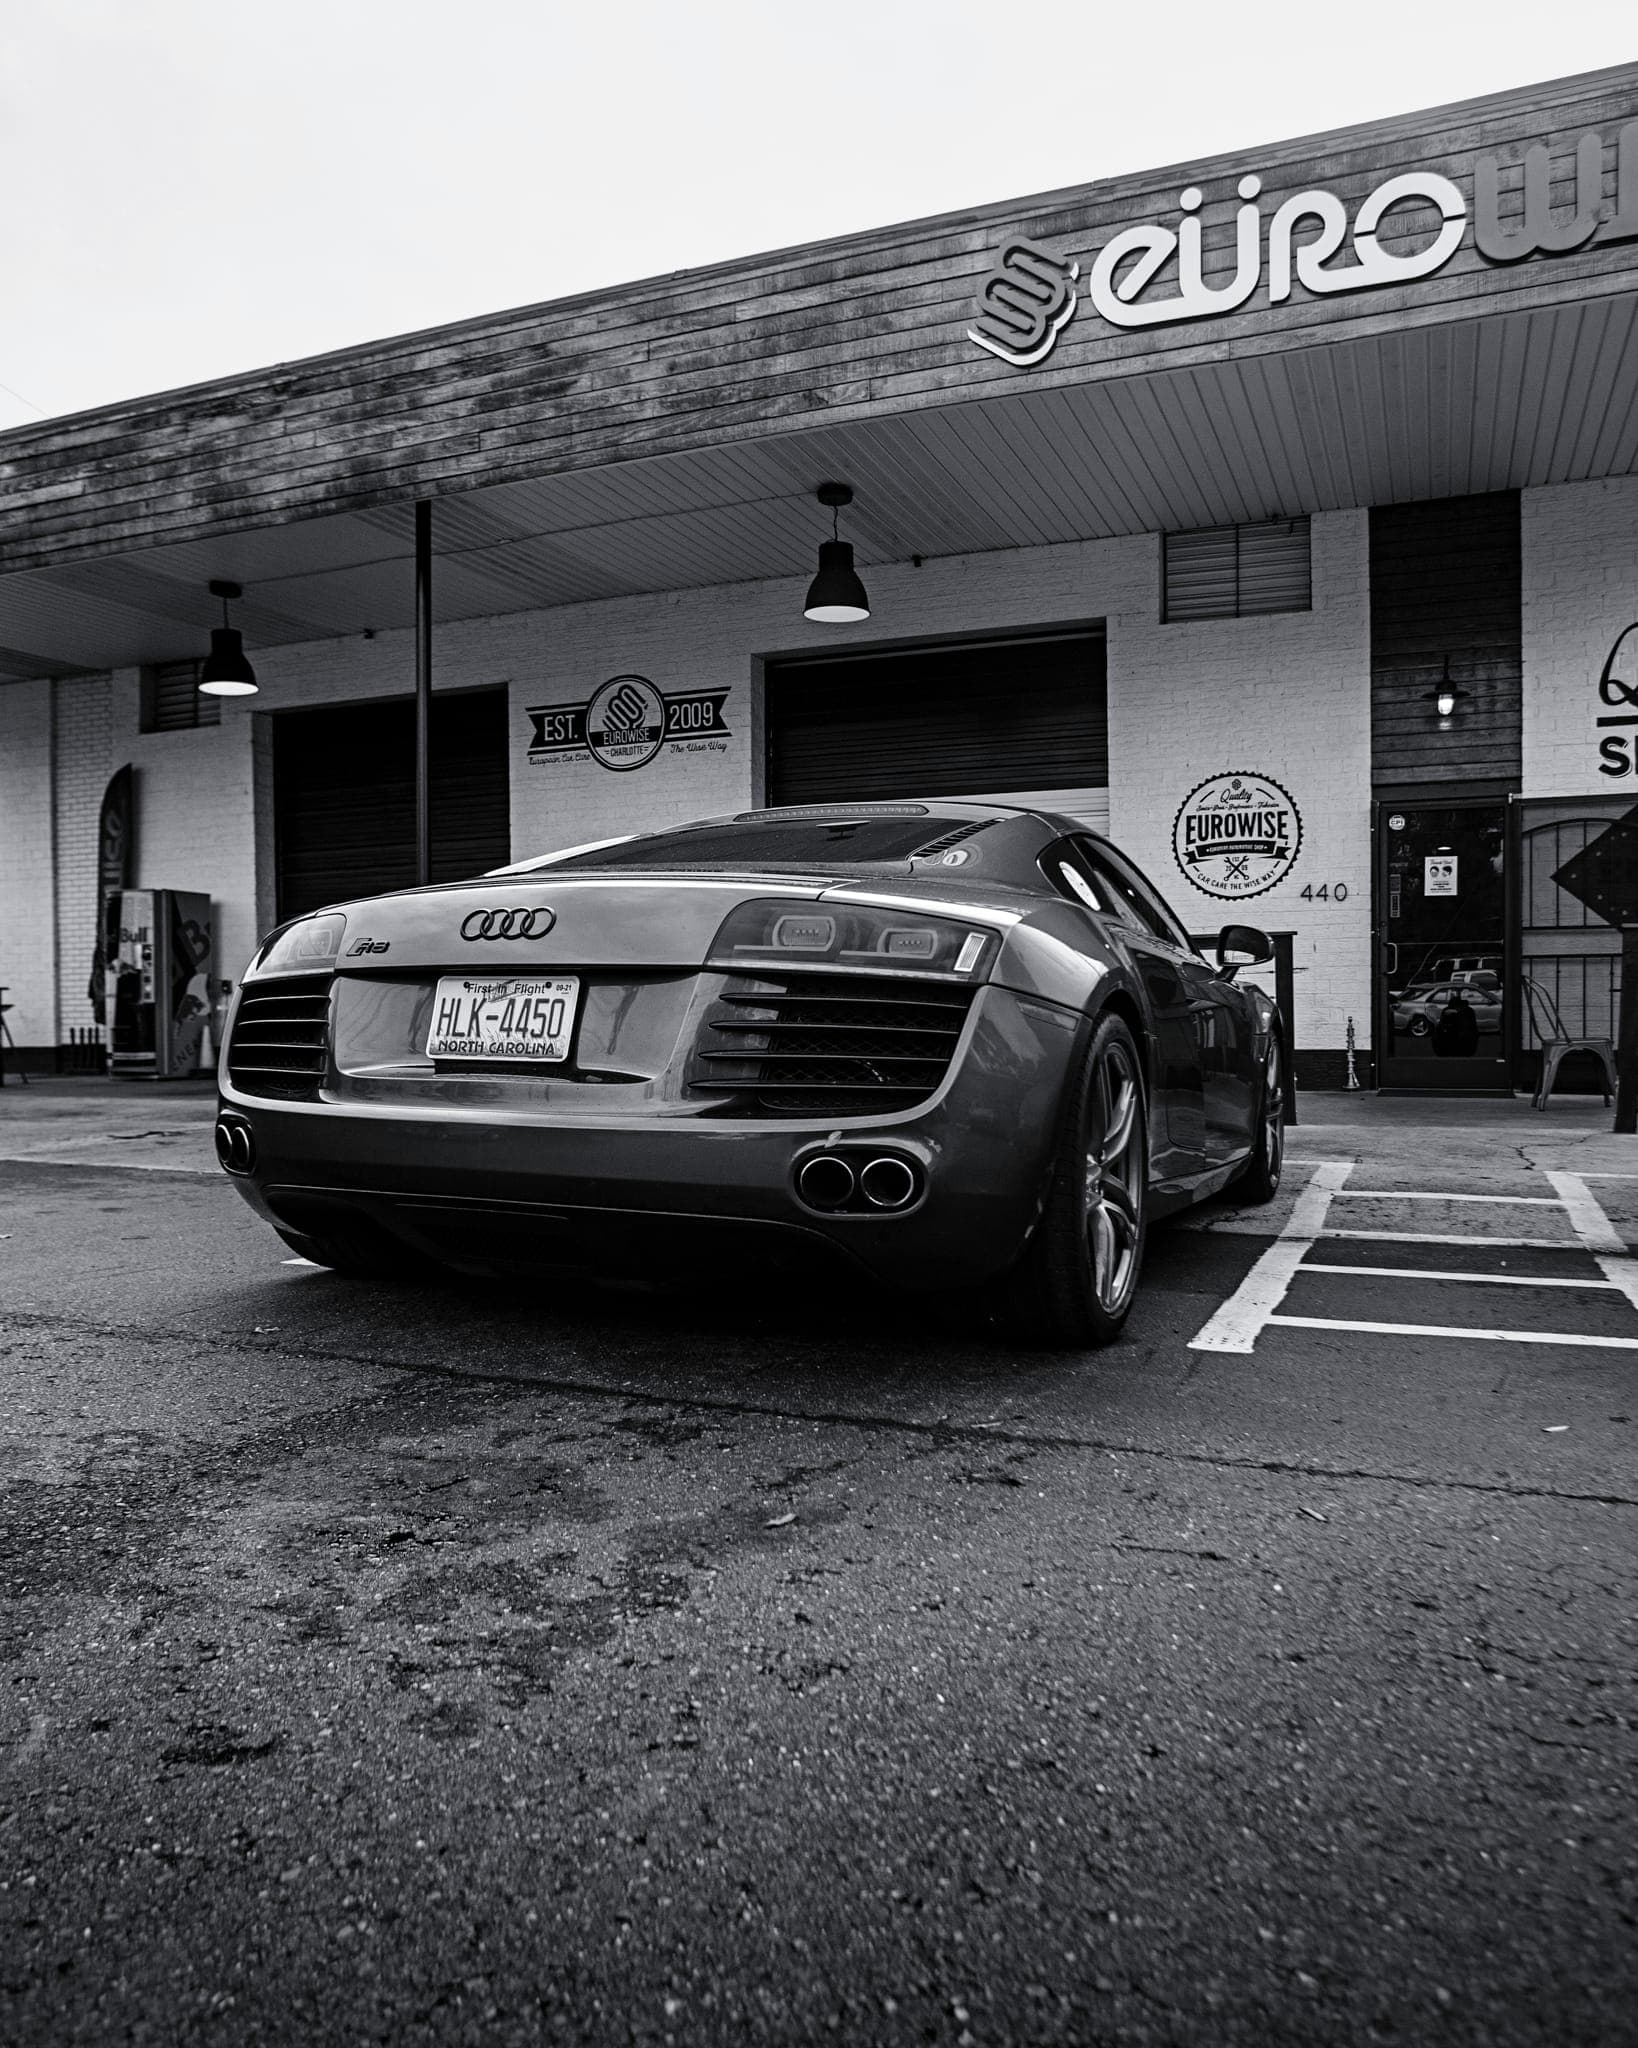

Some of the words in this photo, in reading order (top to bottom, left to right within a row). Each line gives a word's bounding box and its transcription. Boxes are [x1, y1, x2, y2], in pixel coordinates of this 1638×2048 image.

[669, 701, 714, 730] 2009
[543, 714, 578, 742] EST.
[602, 727, 650, 746] EUROWISE
[610, 746, 644, 758] CHARLOTTE
[670, 743, 684, 754] The
[708, 740, 727, 753] Way
[1598, 735, 1638, 778] S
[1220, 788, 1252, 803] Quality
[1186, 811, 1289, 846] EUROWISE
[1197, 873, 1211, 885] CAR
[1211, 879, 1228, 890] CARE
[1301, 883, 1348, 902] 440
[466, 983, 492, 994] First
[514, 983, 545, 996] Flight
[436, 998, 566, 1039] HLK-4450
[438, 1040, 485, 1052] NORTH
[489, 1041, 555, 1055] CAROLINA
